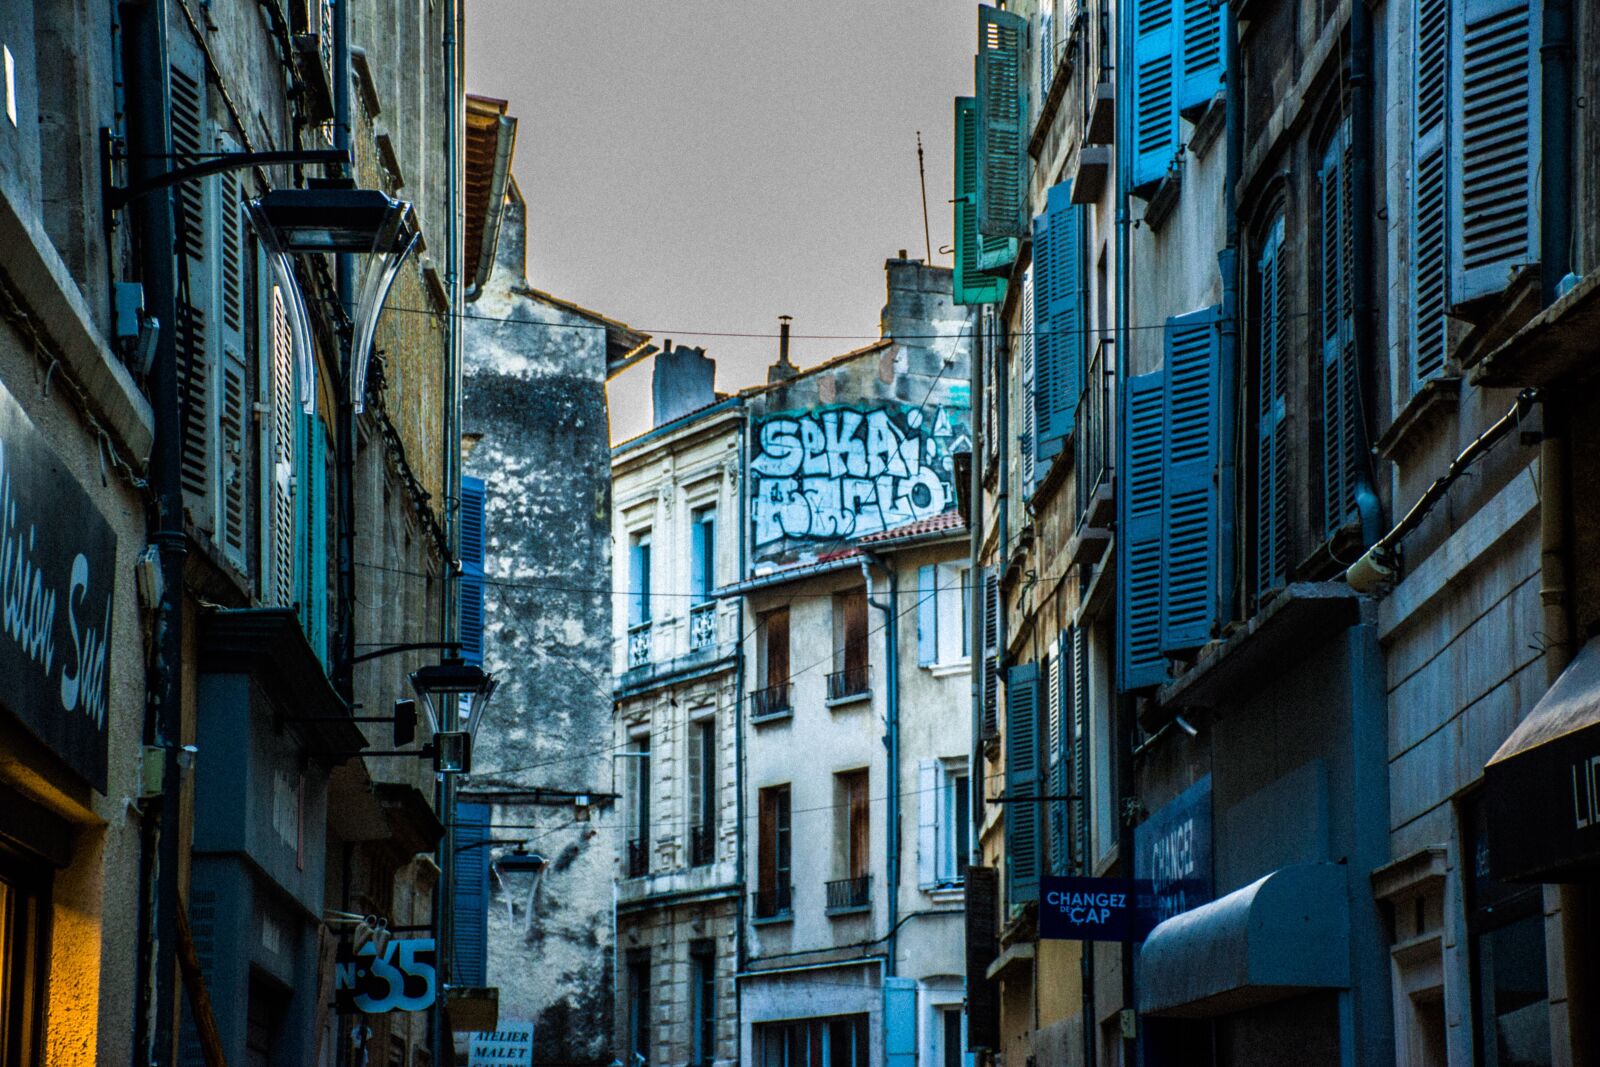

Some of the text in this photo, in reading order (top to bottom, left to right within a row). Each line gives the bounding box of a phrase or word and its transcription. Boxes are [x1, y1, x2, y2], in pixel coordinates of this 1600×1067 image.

[61, 553, 112, 732] Sud
[1152, 818, 1194, 895] CHANGEZ
[1046, 891, 1127, 908] CHANGEZ
[474, 1031, 529, 1042] ATELIER
[474, 1047, 527, 1058] MALET
